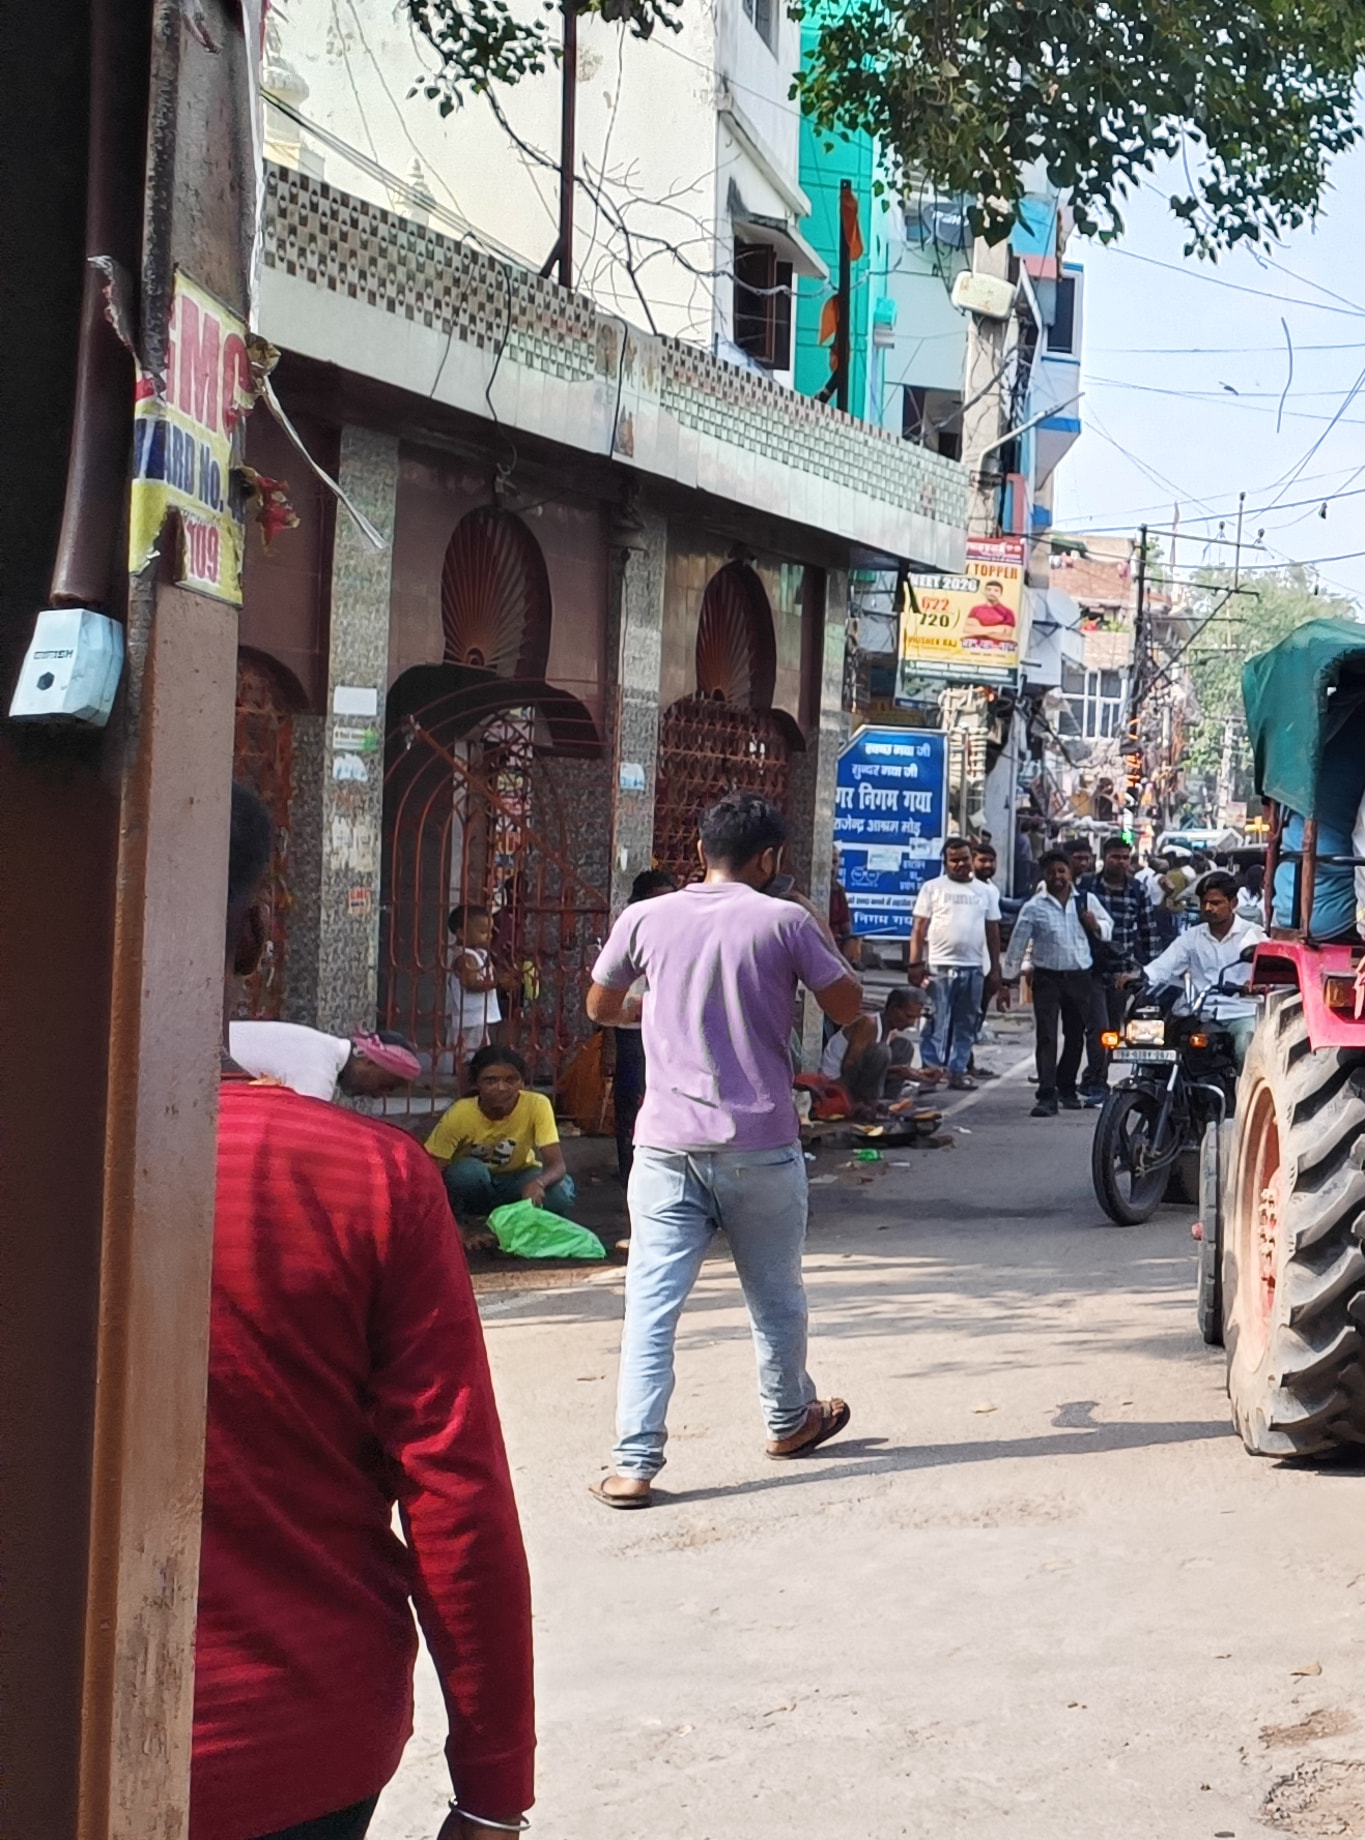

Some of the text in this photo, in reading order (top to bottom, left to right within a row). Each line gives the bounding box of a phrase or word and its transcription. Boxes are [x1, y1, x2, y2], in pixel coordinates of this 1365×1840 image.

[836, 782, 933, 813] गर निगम गया
